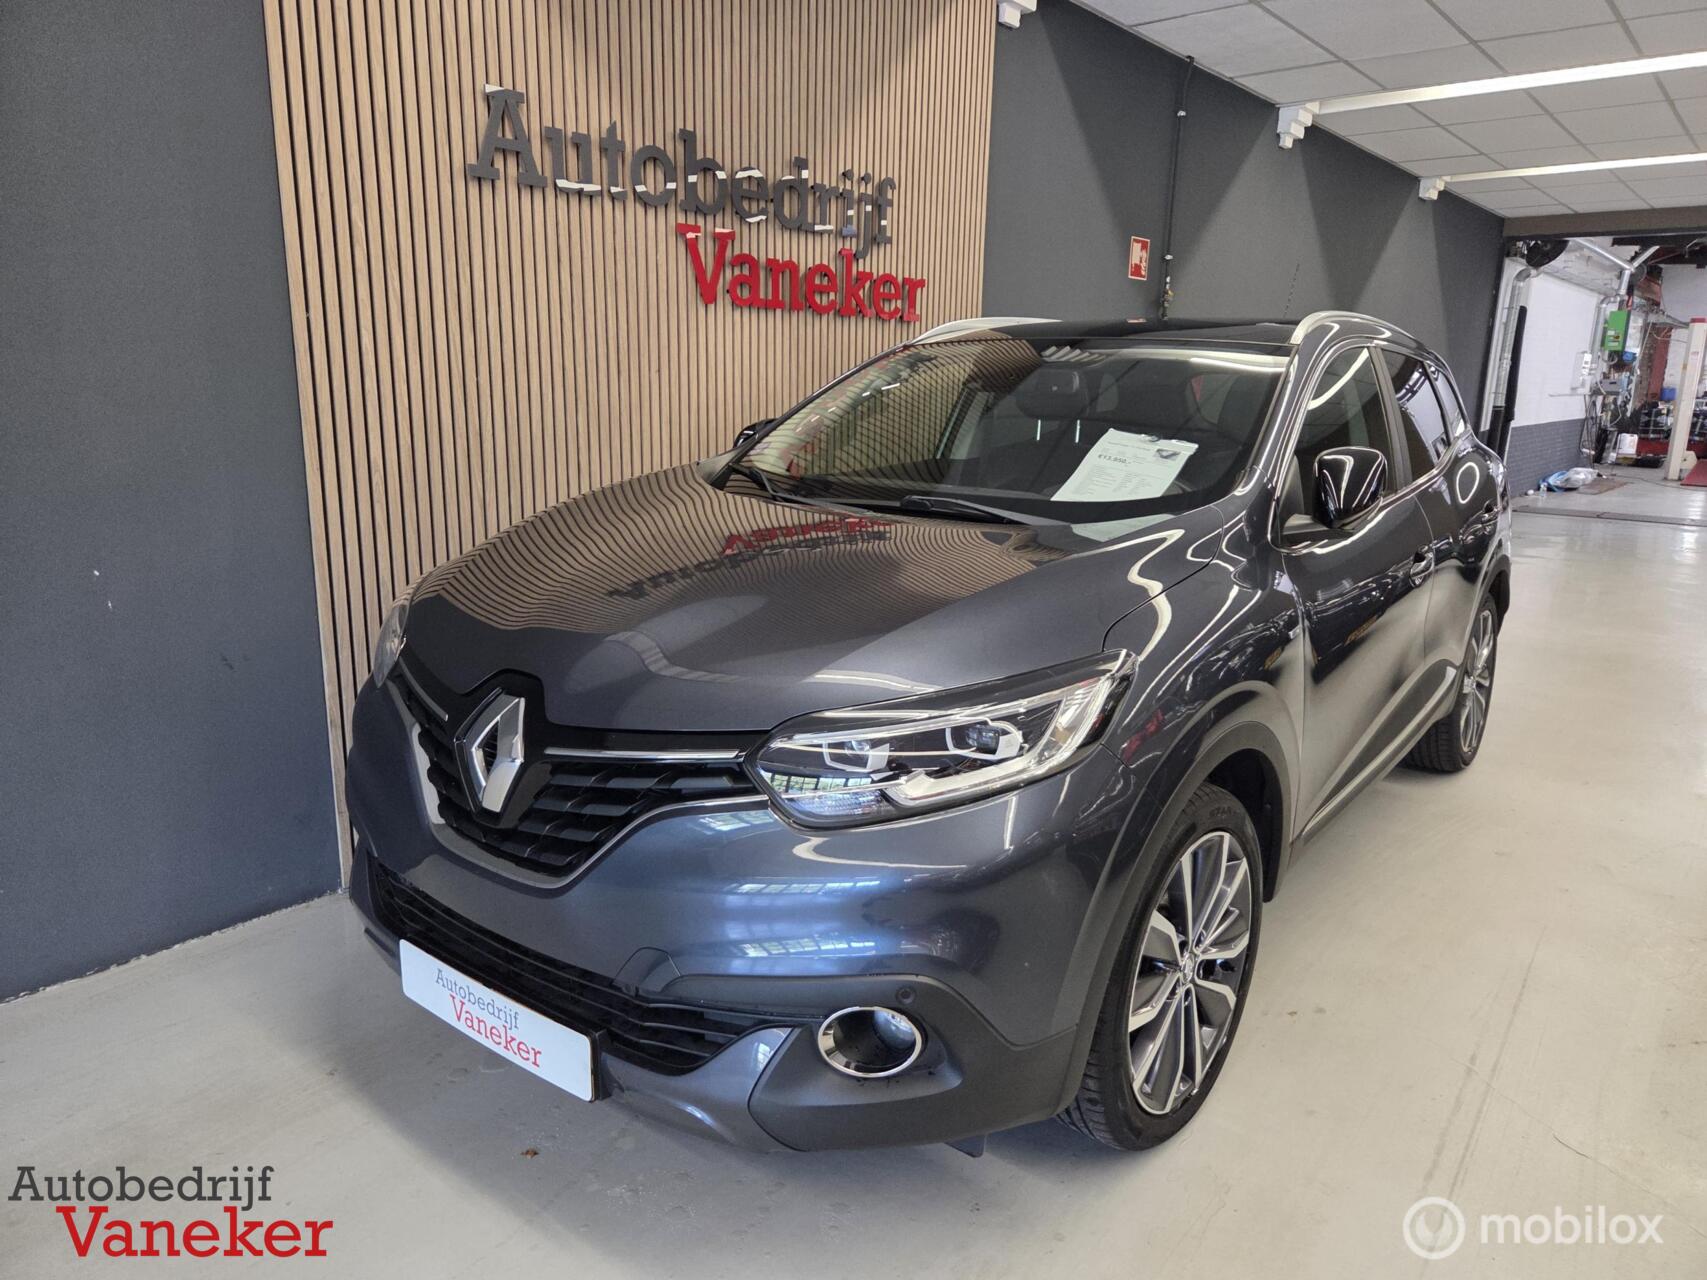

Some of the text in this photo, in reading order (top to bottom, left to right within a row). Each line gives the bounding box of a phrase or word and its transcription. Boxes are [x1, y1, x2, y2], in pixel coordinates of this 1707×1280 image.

[467, 84, 896, 259] Autobedrijf
[677, 223, 925, 321] Vaneker
[435, 968, 519, 1030] Autobedrijf
[450, 994, 542, 1067] Vaneker
